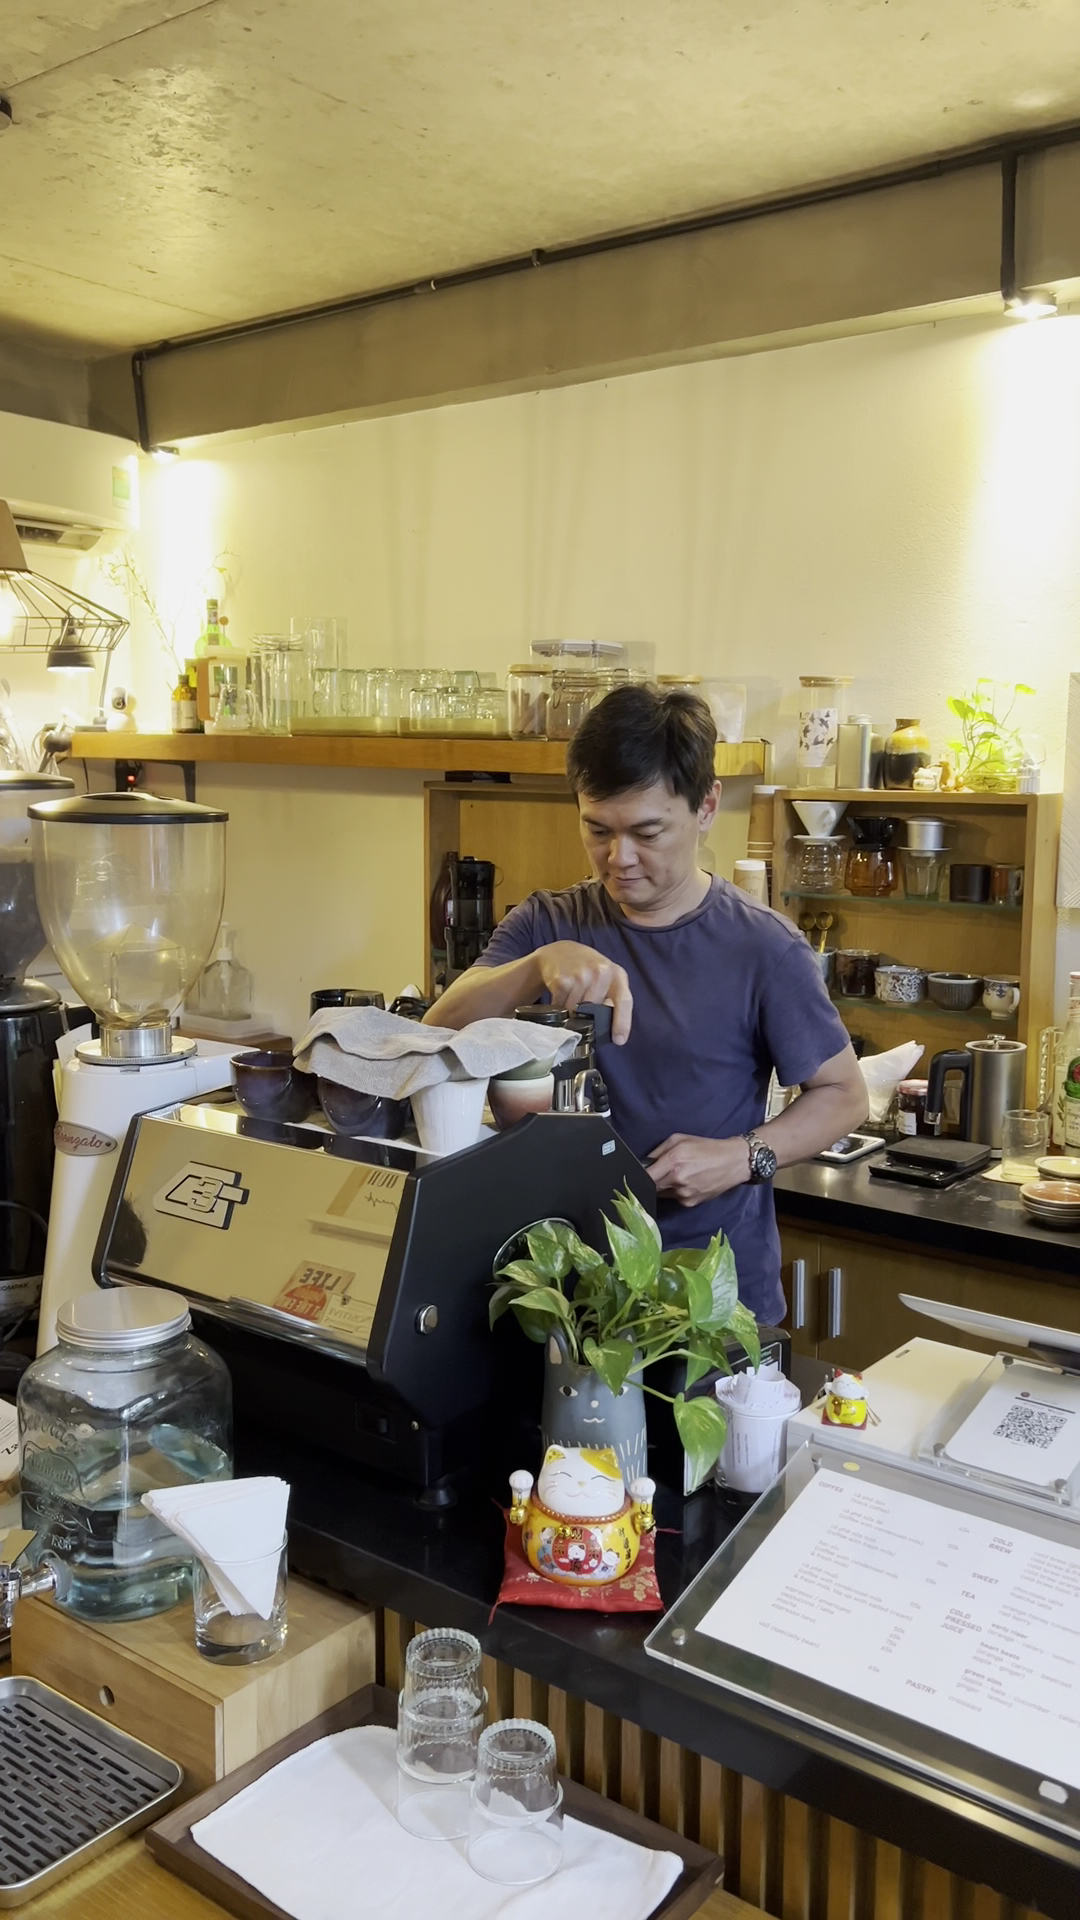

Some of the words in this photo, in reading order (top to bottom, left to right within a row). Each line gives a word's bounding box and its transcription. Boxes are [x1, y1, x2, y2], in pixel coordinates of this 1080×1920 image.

[818, 1481, 844, 1493] COFFEE
[860, 1520, 873, 1528] with
[874, 1526, 908, 1541] condensed
[848, 1537, 862, 1545] with
[862, 1541, 878, 1550] fresh
[988, 1543, 1012, 1555] BREW
[992, 1536, 1014, 1548] COLD
[816, 1553, 832, 1562] fresh
[1030, 1556, 1046, 1565] cold
[1046, 1562, 1064, 1571] brew
[1050, 1556, 1067, 1565] brew
[850, 1559, 884, 1574] condensed
[1026, 1562, 1042, 1570] cold
[1043, 1568, 1060, 1576] brew
[970, 1572, 1000, 1586] SWEET
[1020, 1574, 1034, 1582] cold
[1036, 1580, 1053, 1588] brew
[1024, 1568, 1038, 1576] cold
[1040, 1574, 1056, 1582] brew
[820, 1576, 833, 1584] with
[834, 1582, 868, 1598] condensed
[776, 1597, 796, 1608] mocha
[784, 1586, 814, 1599] espresso
[818, 1598, 852, 1614] americano
[800, 1576, 816, 1585] fresh
[832, 1588, 844, 1596] top
[868, 1602, 890, 1613] salted
[889, 1610, 914, 1622] cream)
[960, 1590, 976, 1600] TEA
[1009, 1592, 1034, 1604] matcha
[1036, 1602, 1052, 1610] latte
[1012, 1586, 1046, 1600] chocolate
[1048, 1598, 1064, 1607] latte
[780, 1591, 814, 1608] cappuccino
[820, 1606, 834, 1615] latte
[772, 1603, 800, 1617] espresso
[801, 1614, 816, 1624] tonic
[950, 1608, 970, 1620] COLD
[999, 1610, 1012, 1618] red
[1012, 1615, 1032, 1626] berry
[1002, 1604, 1026, 1616] orange
[1028, 1613, 1049, 1625] honey
[940, 1622, 964, 1635] JUICE
[945, 1614, 982, 1633] PRESSED
[991, 1623, 1009, 1633] early
[1010, 1630, 1028, 1639] riser
[770, 1625, 800, 1642] (specialty
[801, 1638, 820, 1648] bean)
[980, 1642, 999, 1652] heart
[1022, 1643, 1044, 1654] celery
[1052, 1654, 1075, 1665] lemon
[972, 1656, 992, 1666] apple
[1011, 1662, 1034, 1674] carrot
[964, 1668, 986, 1680] green
[986, 1677, 1002, 1687] slim
[906, 1679, 937, 1695] PASTRY
[956, 1682, 980, 1693] ginger
[948, 1696, 982, 1712] croissant
[990, 1686, 1006, 1696] kale
[1014, 1696, 1050, 1713] cucumber
